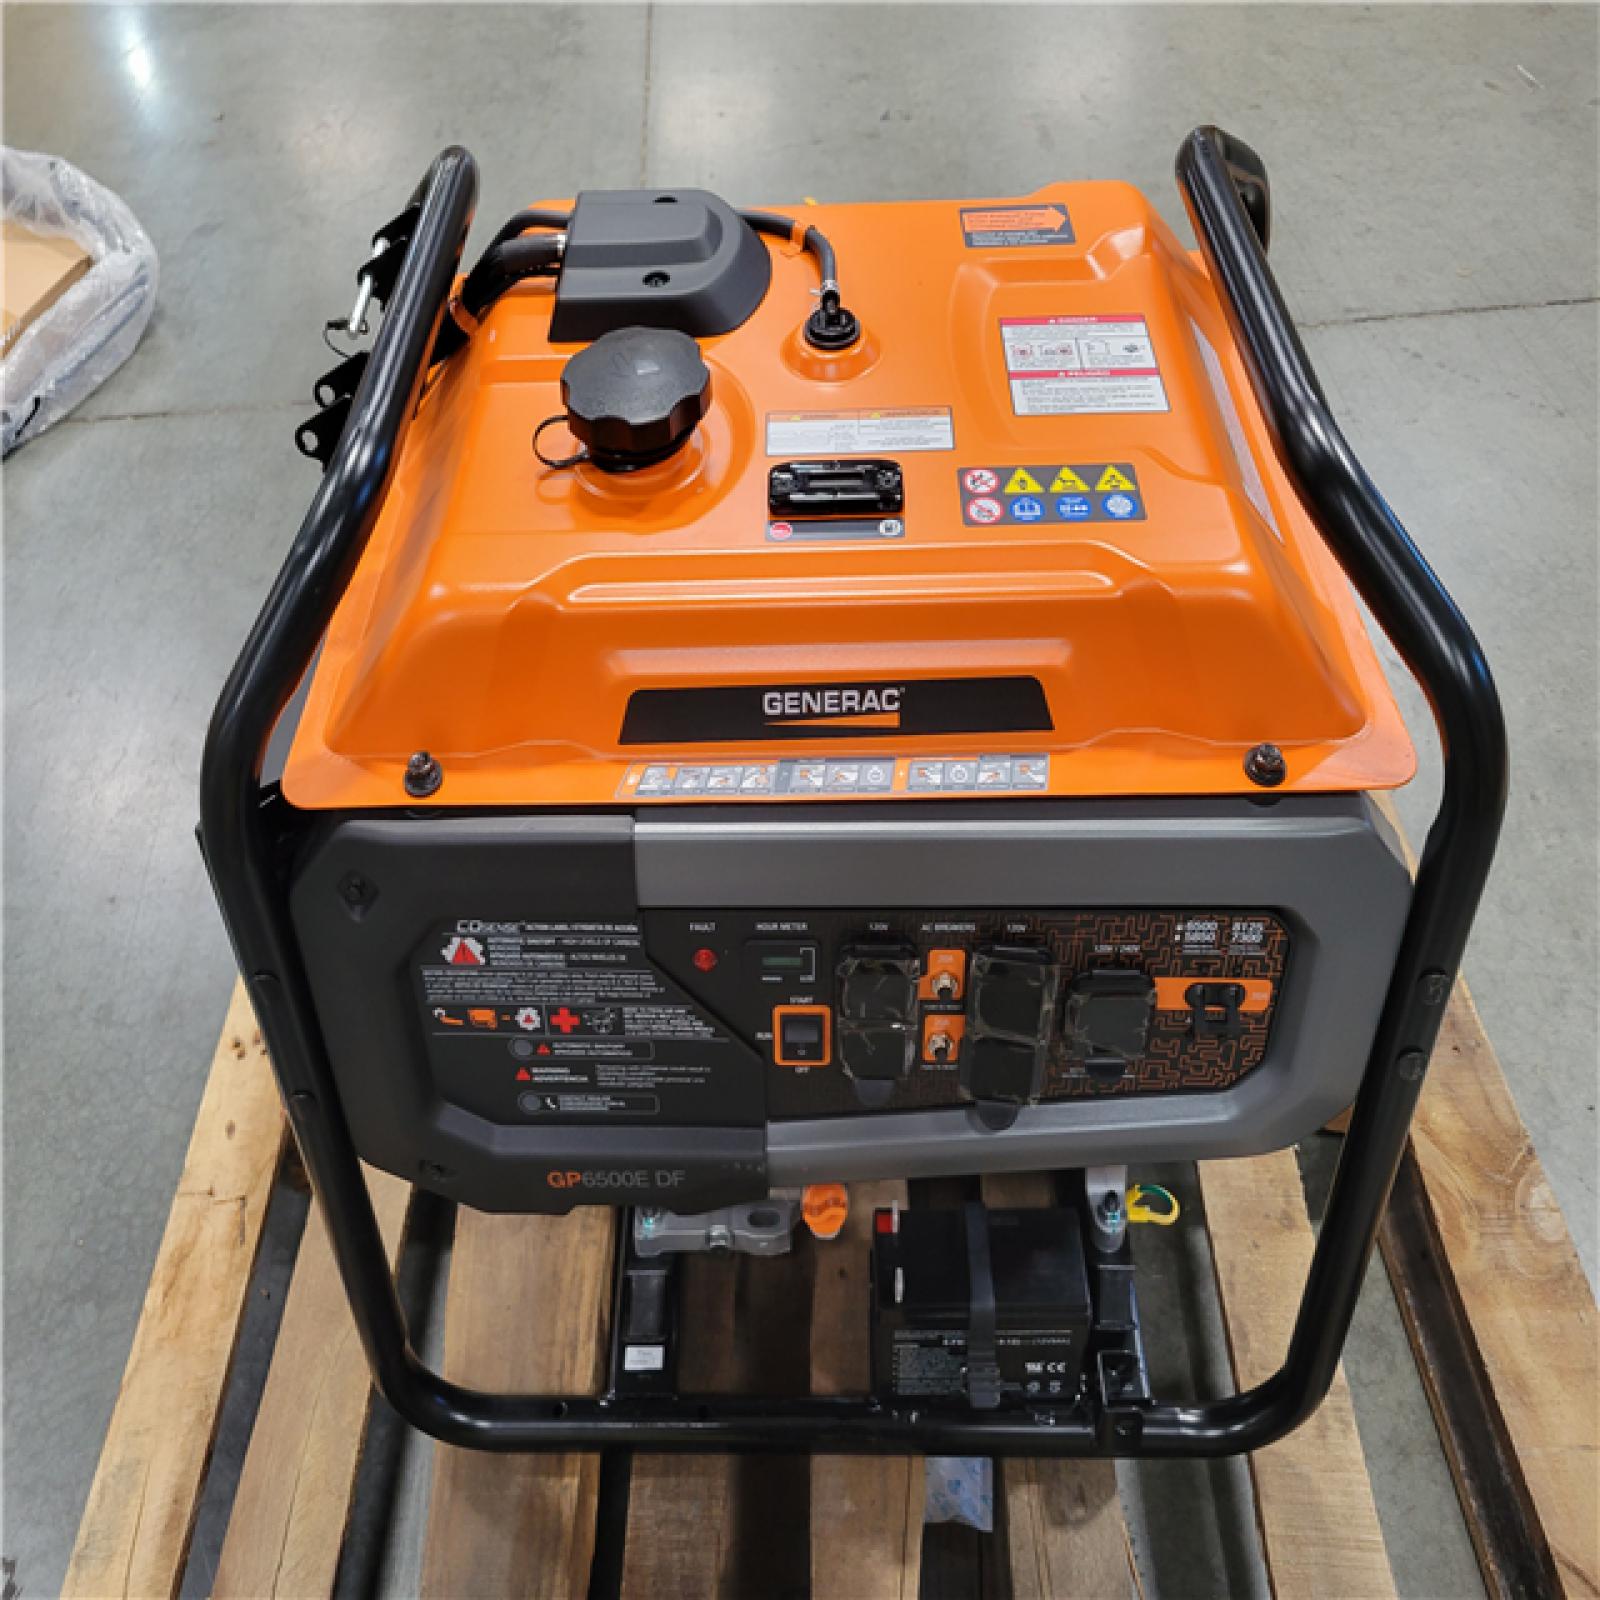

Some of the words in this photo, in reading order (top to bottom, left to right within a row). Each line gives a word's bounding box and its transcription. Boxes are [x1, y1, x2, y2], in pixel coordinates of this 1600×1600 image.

[762, 688, 901, 716] GENERAC
[546, 1170, 650, 1188] GP6500E
[655, 1170, 686, 1188] DF
